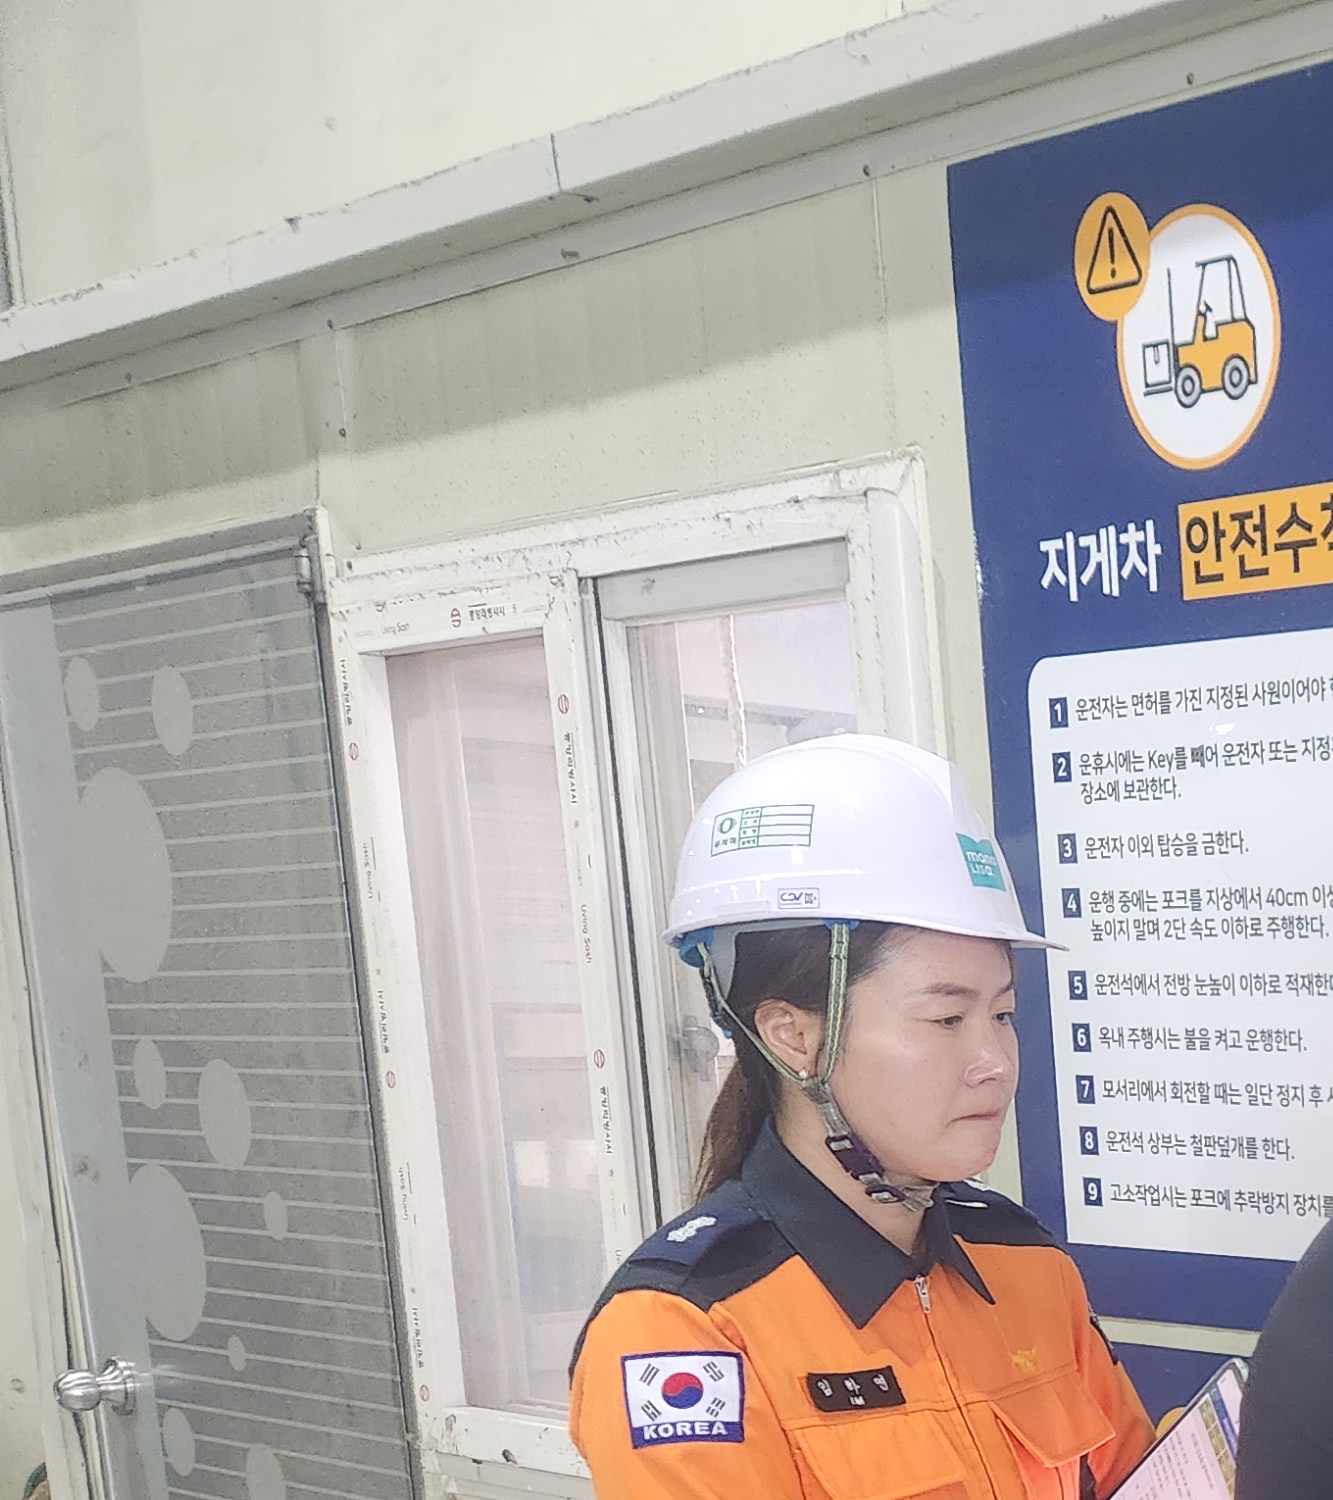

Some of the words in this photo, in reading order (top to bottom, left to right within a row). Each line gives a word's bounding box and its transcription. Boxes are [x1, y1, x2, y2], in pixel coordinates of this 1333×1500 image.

[1039, 518, 1161, 602] 지게차
[1053, 702, 1064, 723] 1
[1075, 695, 1128, 722] 운전자는
[1131, 692, 1171, 716] 면허를
[1175, 687, 1201, 713] 가진
[1206, 683, 1248, 710] 지정된
[1252, 675, 1325, 703] 사원이어야
[1056, 757, 1068, 777] 2
[1079, 750, 1144, 776] 운휴시에는
[1148, 746, 1187, 771] Key를
[1222, 740, 1264, 767] 운전자
[1268, 739, 1297, 763] 또는
[1080, 780, 1119, 805] 장소에
[1123, 776, 1182, 801] 보관한다.
[1062, 838, 1073, 858] 3
[1084, 834, 1124, 859] 운전자
[1128, 834, 1153, 858] 이외
[1157, 833, 1198, 857] 탑승을
[1202, 830, 1249, 854] 금한다.
[1066, 893, 1078, 913] 4
[1088, 890, 1115, 914] 운행
[1118, 890, 1158, 912] 중에는
[1162, 889, 1202, 911] 포크를
[1206, 886, 1262, 911] 지상에서
[1266, 887, 1308, 907] 40cm
[1091, 918, 1129, 942] 높이지
[1133, 918, 1160, 941] 말며
[1164, 918, 1186, 939] 2단
[1190, 917, 1217, 941] 속도
[1221, 916, 1263, 940] 이하로
[1267, 916, 1329, 939] 주행한다.
[1072, 975, 1083, 995] 5
[1094, 974, 1159, 997] 운전석에서
[1164, 974, 1190, 997] 전방
[1194, 973, 1236, 996] 눈높이
[1240, 973, 1281, 996] 이하로
[1076, 1028, 1087, 1047] 6
[1098, 1027, 1124, 1050] 옥내
[1128, 1027, 1180, 1050] 주행시는
[1184, 1028, 1210, 1050] 불을
[1215, 1029, 1241, 1051] 켜고
[1245, 1028, 1307, 1053] 운행한다.
[1080, 1080, 1091, 1098] 7
[1103, 1080, 1166, 1103] 모서리에서
[1170, 1081, 1210, 1104] 회전할
[1214, 1083, 1244, 1106] 때는
[1245, 1083, 1272, 1107] 일단
[1276, 1085, 1304, 1108] 정지
[1309, 1085, 1323, 1108] 후
[1083, 1131, 1094, 1150] 8
[1106, 1131, 1143, 1154] 운전석
[1148, 1133, 1187, 1155] 상부는
[1190, 1134, 1258, 1159] 철판덮개를
[1262, 1138, 1295, 1161] 한다.
[1086, 1182, 1098, 1201] 9
[1109, 1184, 1187, 1209] 고소작업시는
[1191, 1188, 1230, 1211] 포크에
[1234, 1192, 1289, 1216] 추락방지
[644, 1421, 728, 1440] KOREA
